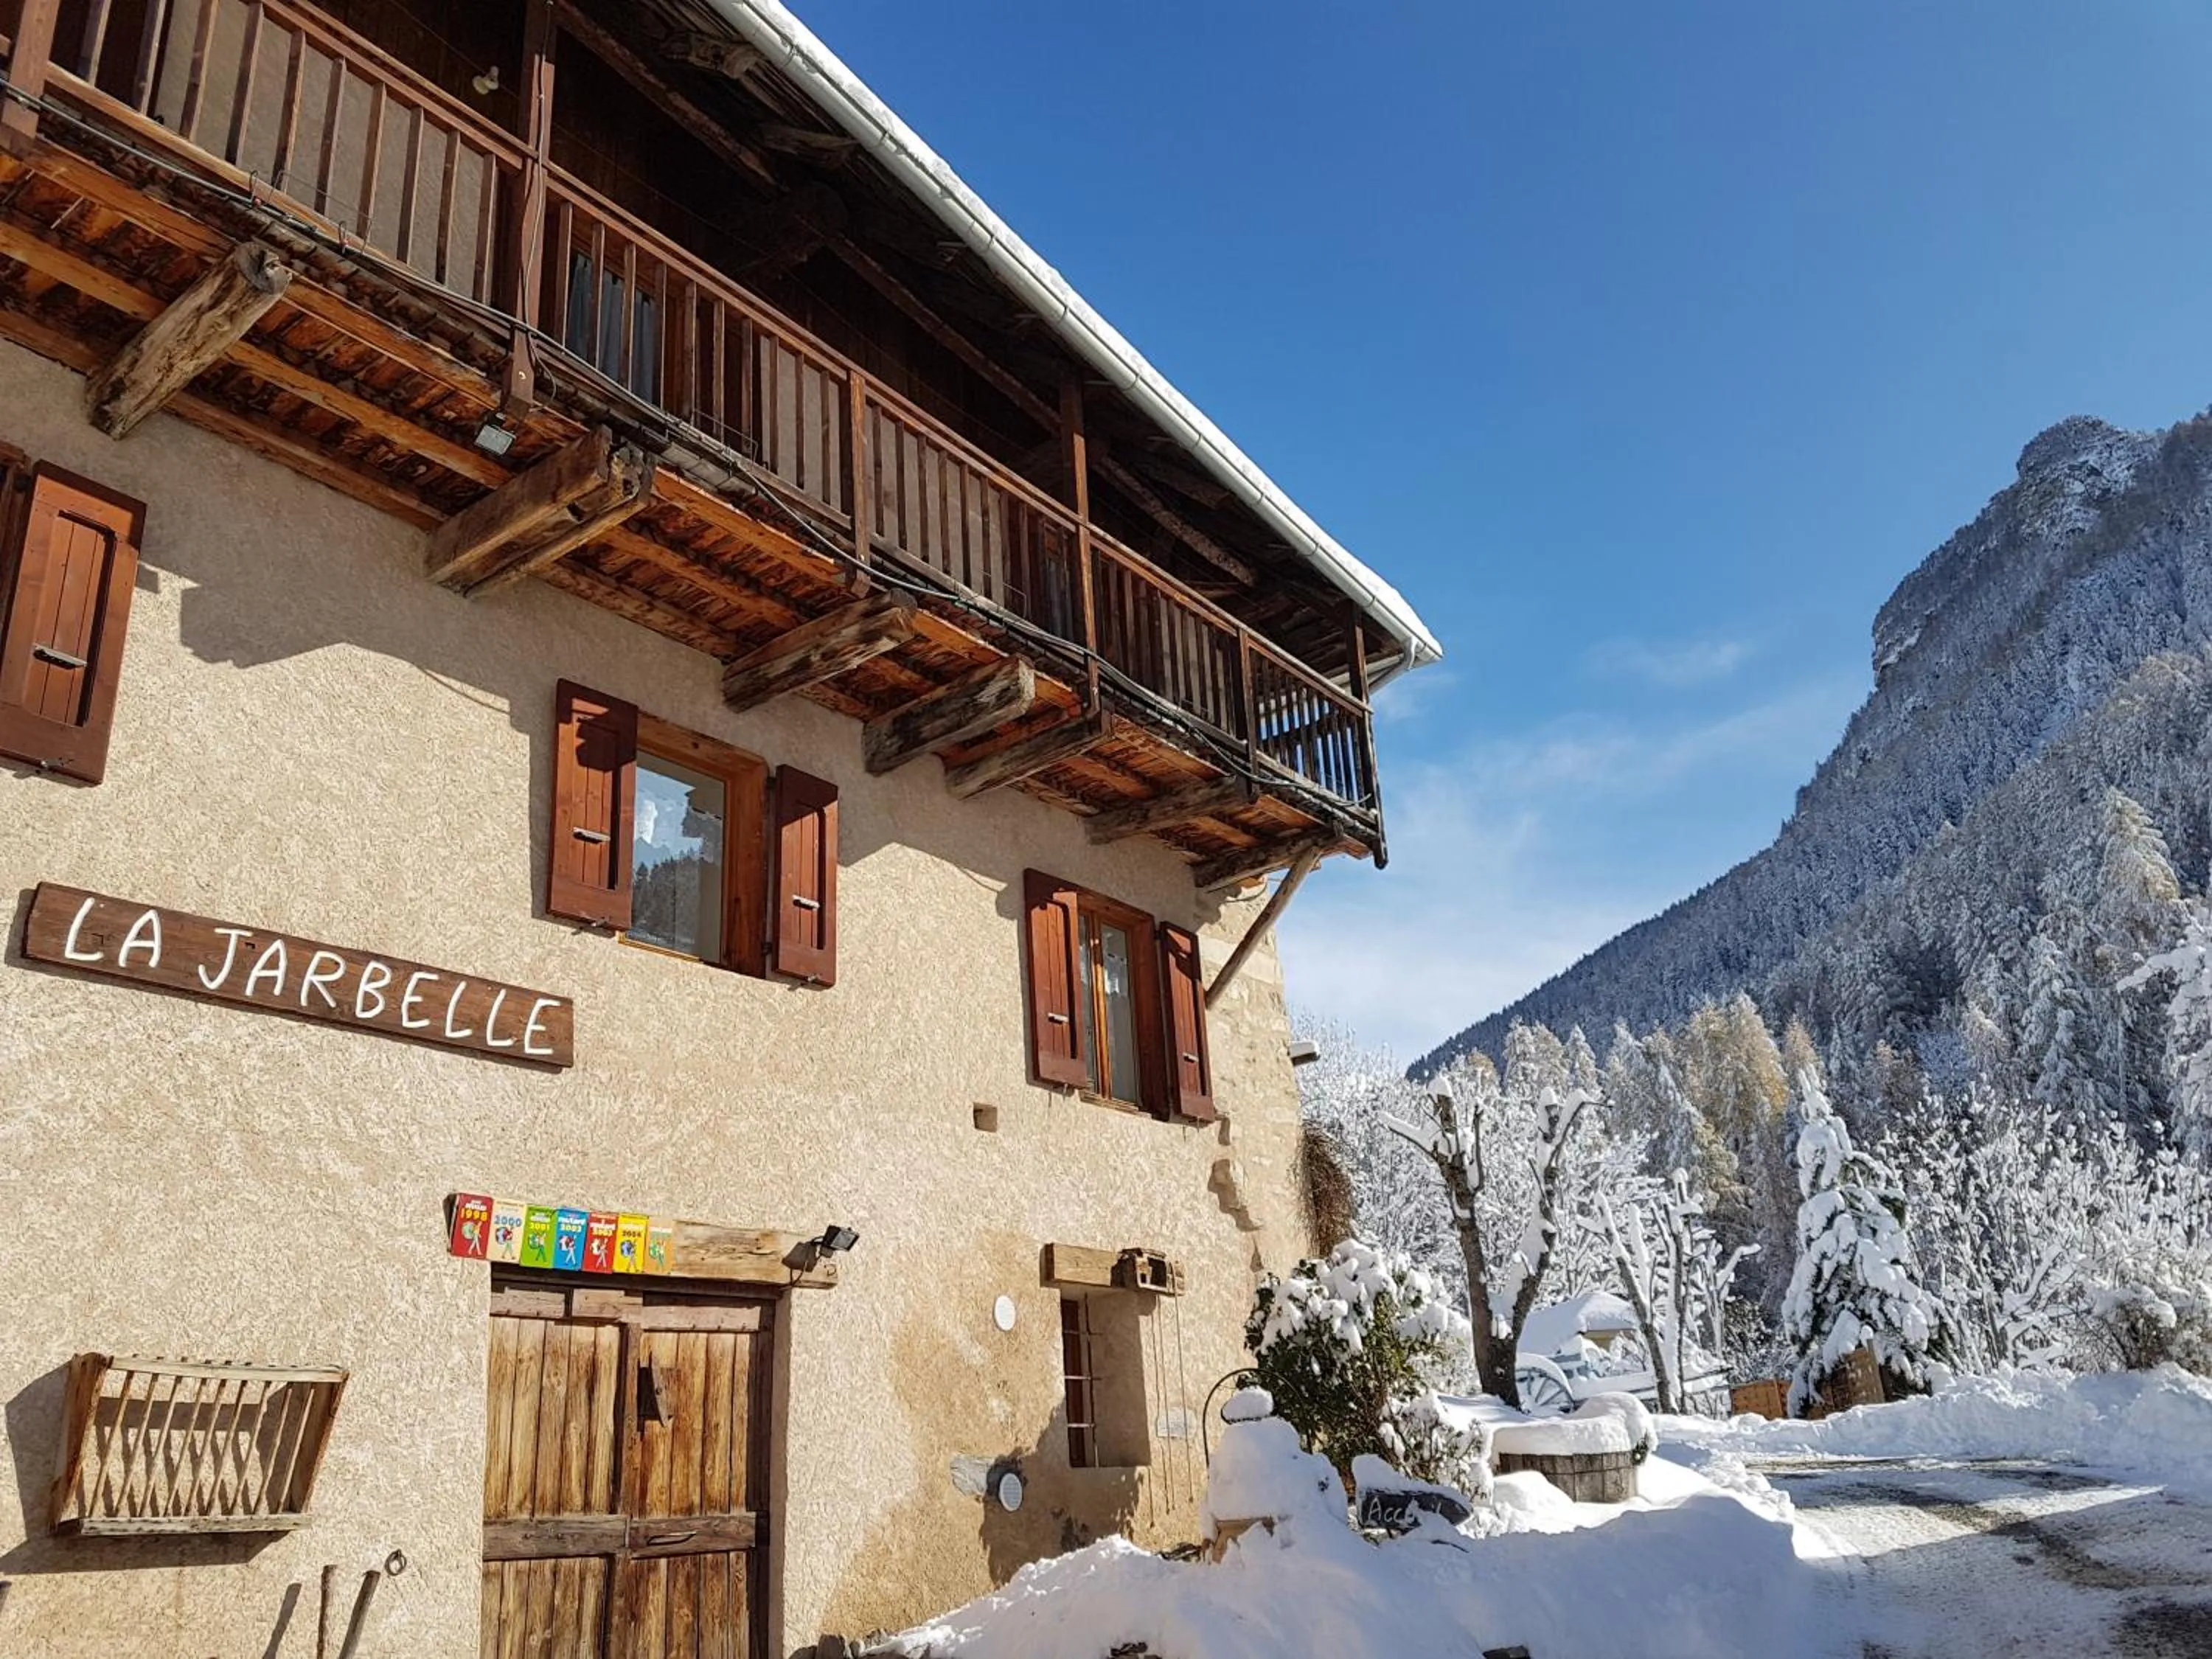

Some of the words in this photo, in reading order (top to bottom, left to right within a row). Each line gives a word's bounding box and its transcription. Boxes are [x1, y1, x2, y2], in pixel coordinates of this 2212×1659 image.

[63, 897, 162, 967] LA
[198, 928, 561, 1055] JARBELLE
[460, 1207, 487, 1222] 1998
[494, 1215, 522, 1227] 2000
